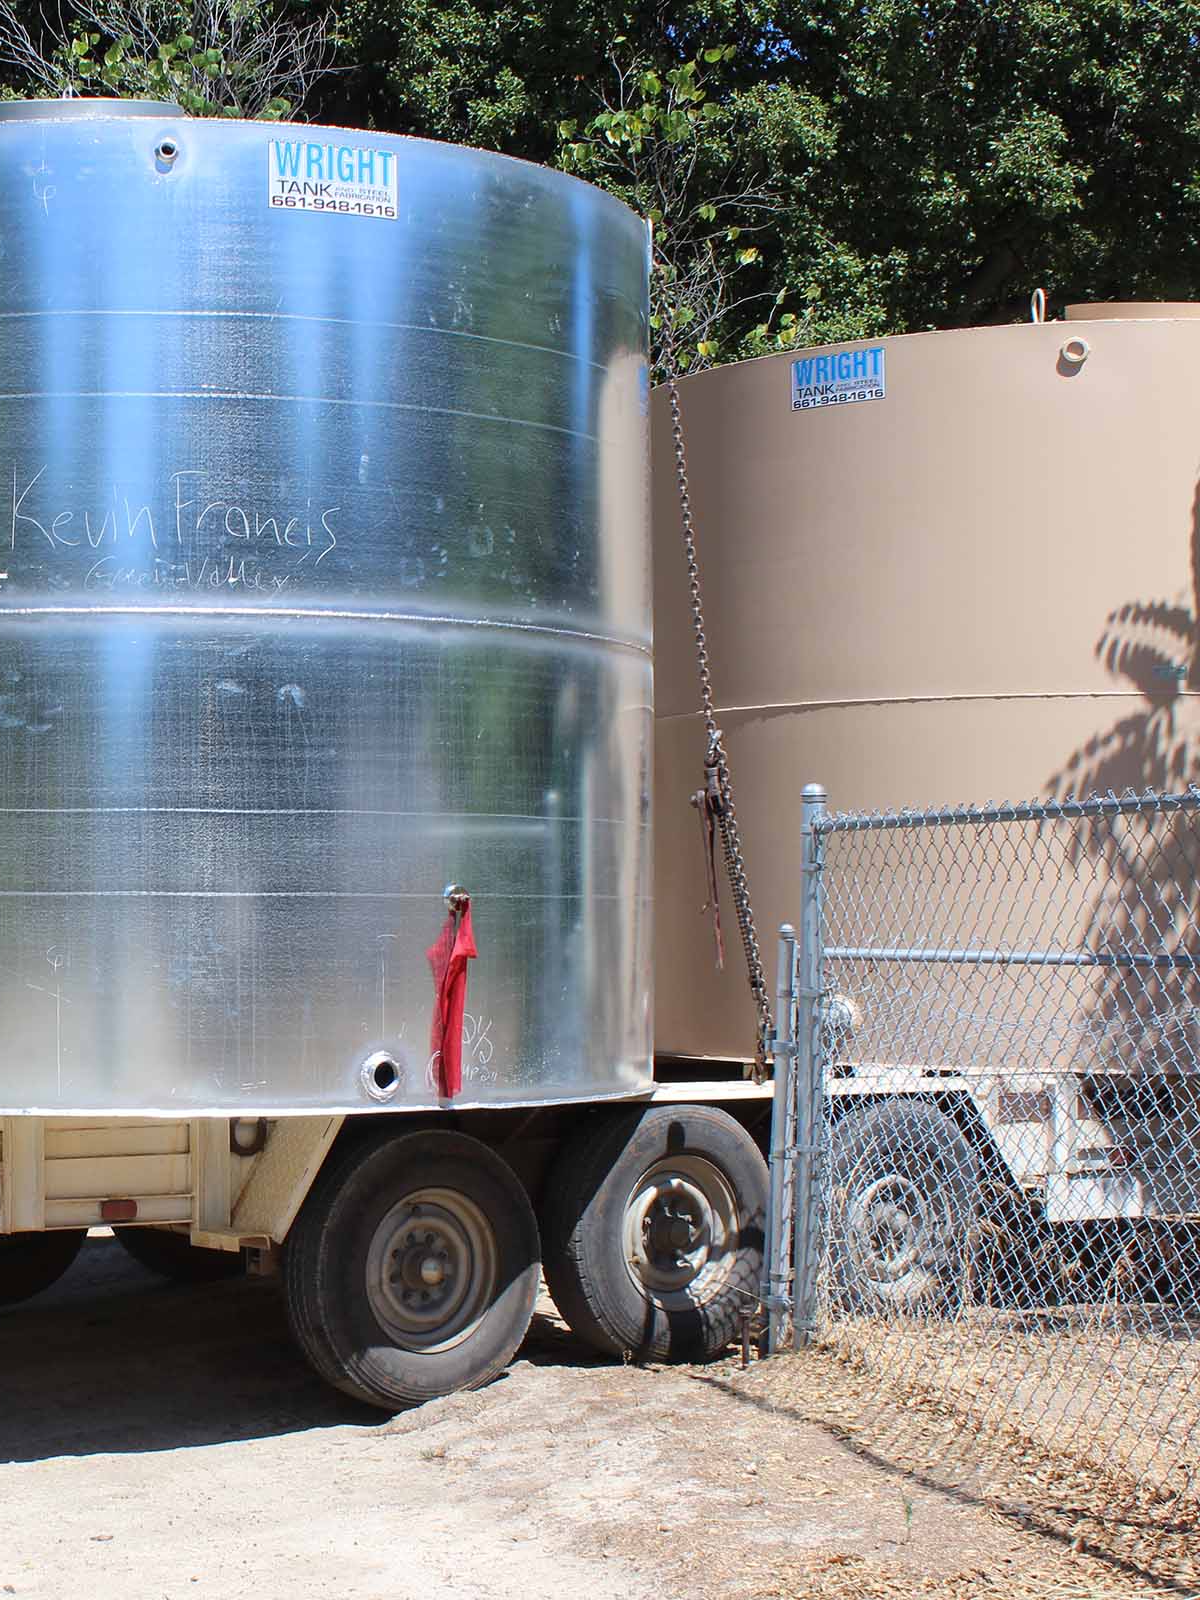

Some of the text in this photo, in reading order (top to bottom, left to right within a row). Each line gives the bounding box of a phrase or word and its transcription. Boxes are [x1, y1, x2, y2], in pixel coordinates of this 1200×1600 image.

[275, 140, 393, 187] WRIGHT
[276, 179, 333, 198] TANK
[272, 195, 395, 217] 661-948-1616
[795, 347, 883, 386] WRIGHT
[793, 388, 884, 409] 661-948-1616
[797, 383, 835, 400] TANK
[9, 463, 341, 566] Kevin Francis
